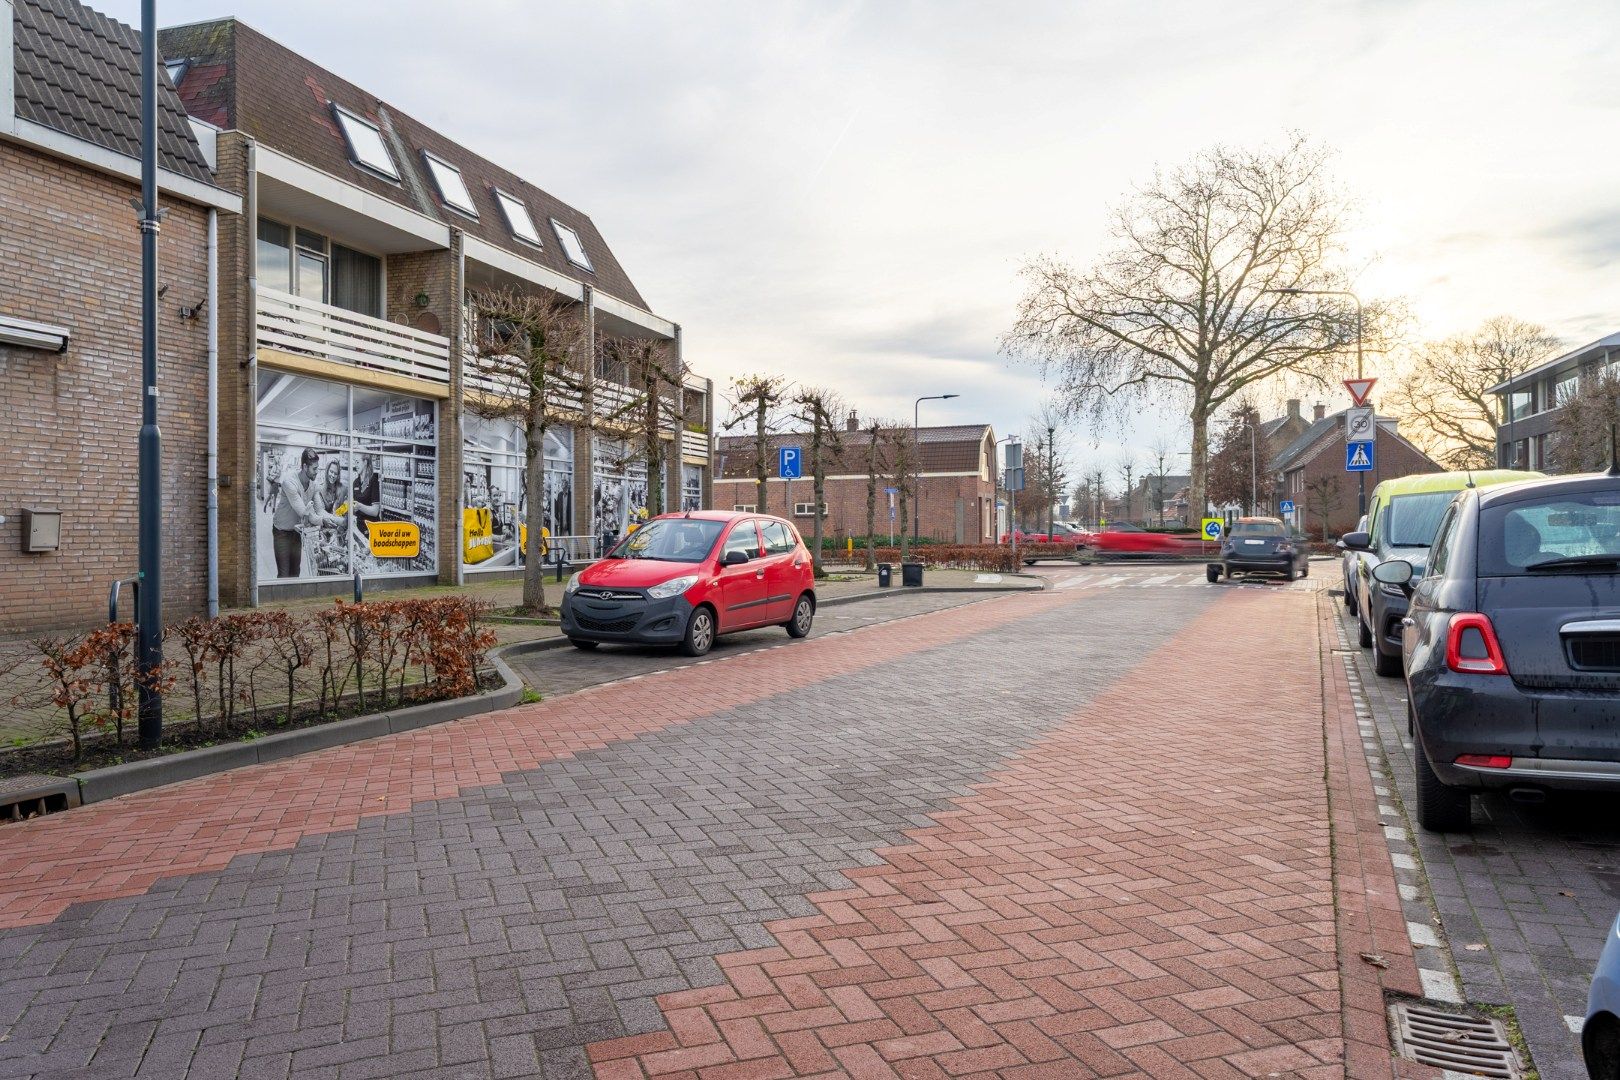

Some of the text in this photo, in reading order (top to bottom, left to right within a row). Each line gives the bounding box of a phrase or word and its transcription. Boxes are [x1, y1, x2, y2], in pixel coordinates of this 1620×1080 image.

[1353, 420, 1368, 429] 30
[784, 449, 796, 466] P
[379, 529, 393, 538] Voor
[373, 538, 417, 550] boodschappen
